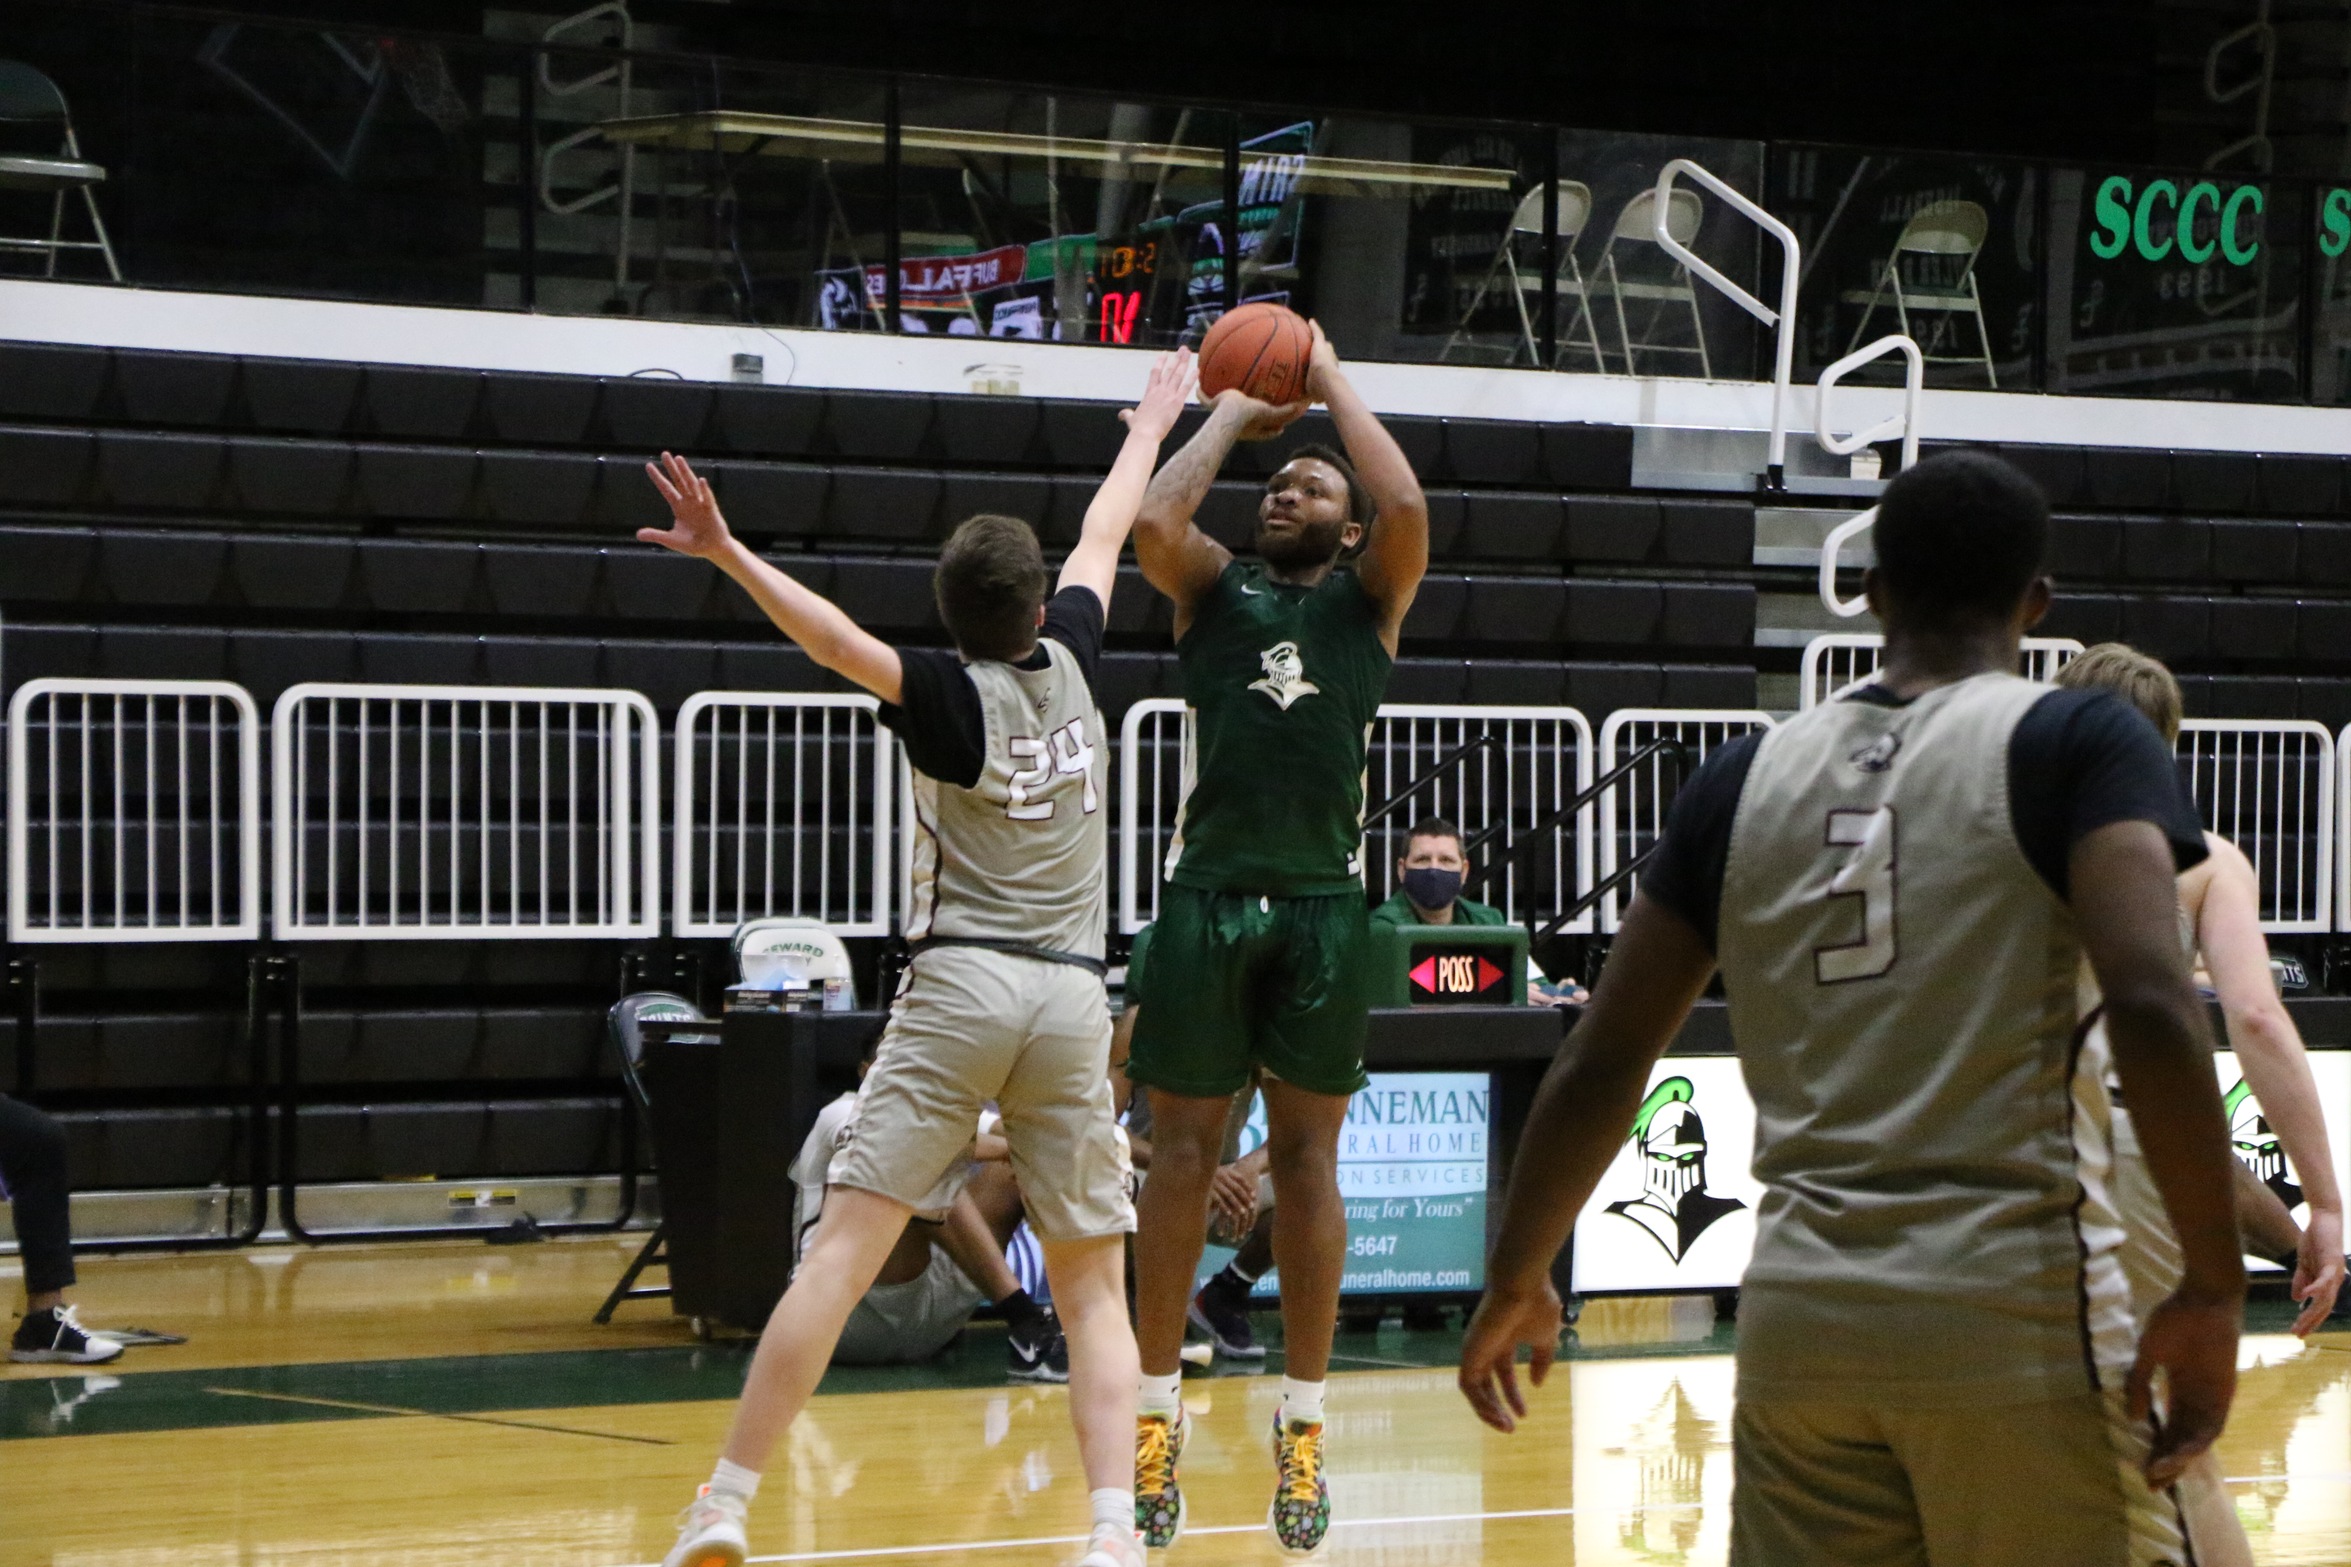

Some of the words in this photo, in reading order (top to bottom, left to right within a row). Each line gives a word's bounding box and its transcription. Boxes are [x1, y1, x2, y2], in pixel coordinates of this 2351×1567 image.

[2090, 176, 2263, 266] SCCC
[1006, 716, 1098, 820] 24
[1813, 803, 1900, 986] 3
[1438, 956, 1474, 993] POSS
[1346, 1090, 1489, 1125] NNEMAN
[1348, 1132, 1401, 1153] RAL
[1409, 1132, 1481, 1154] HOME
[1336, 1170, 1363, 1185] ON
[1374, 1168, 1483, 1185] SERVICES
[1345, 1199, 1379, 1223] ring
[1382, 1198, 1408, 1218] for
[1347, 1235, 1398, 1256] -5647
[1340, 1269, 1470, 1289] uneralhome.com
